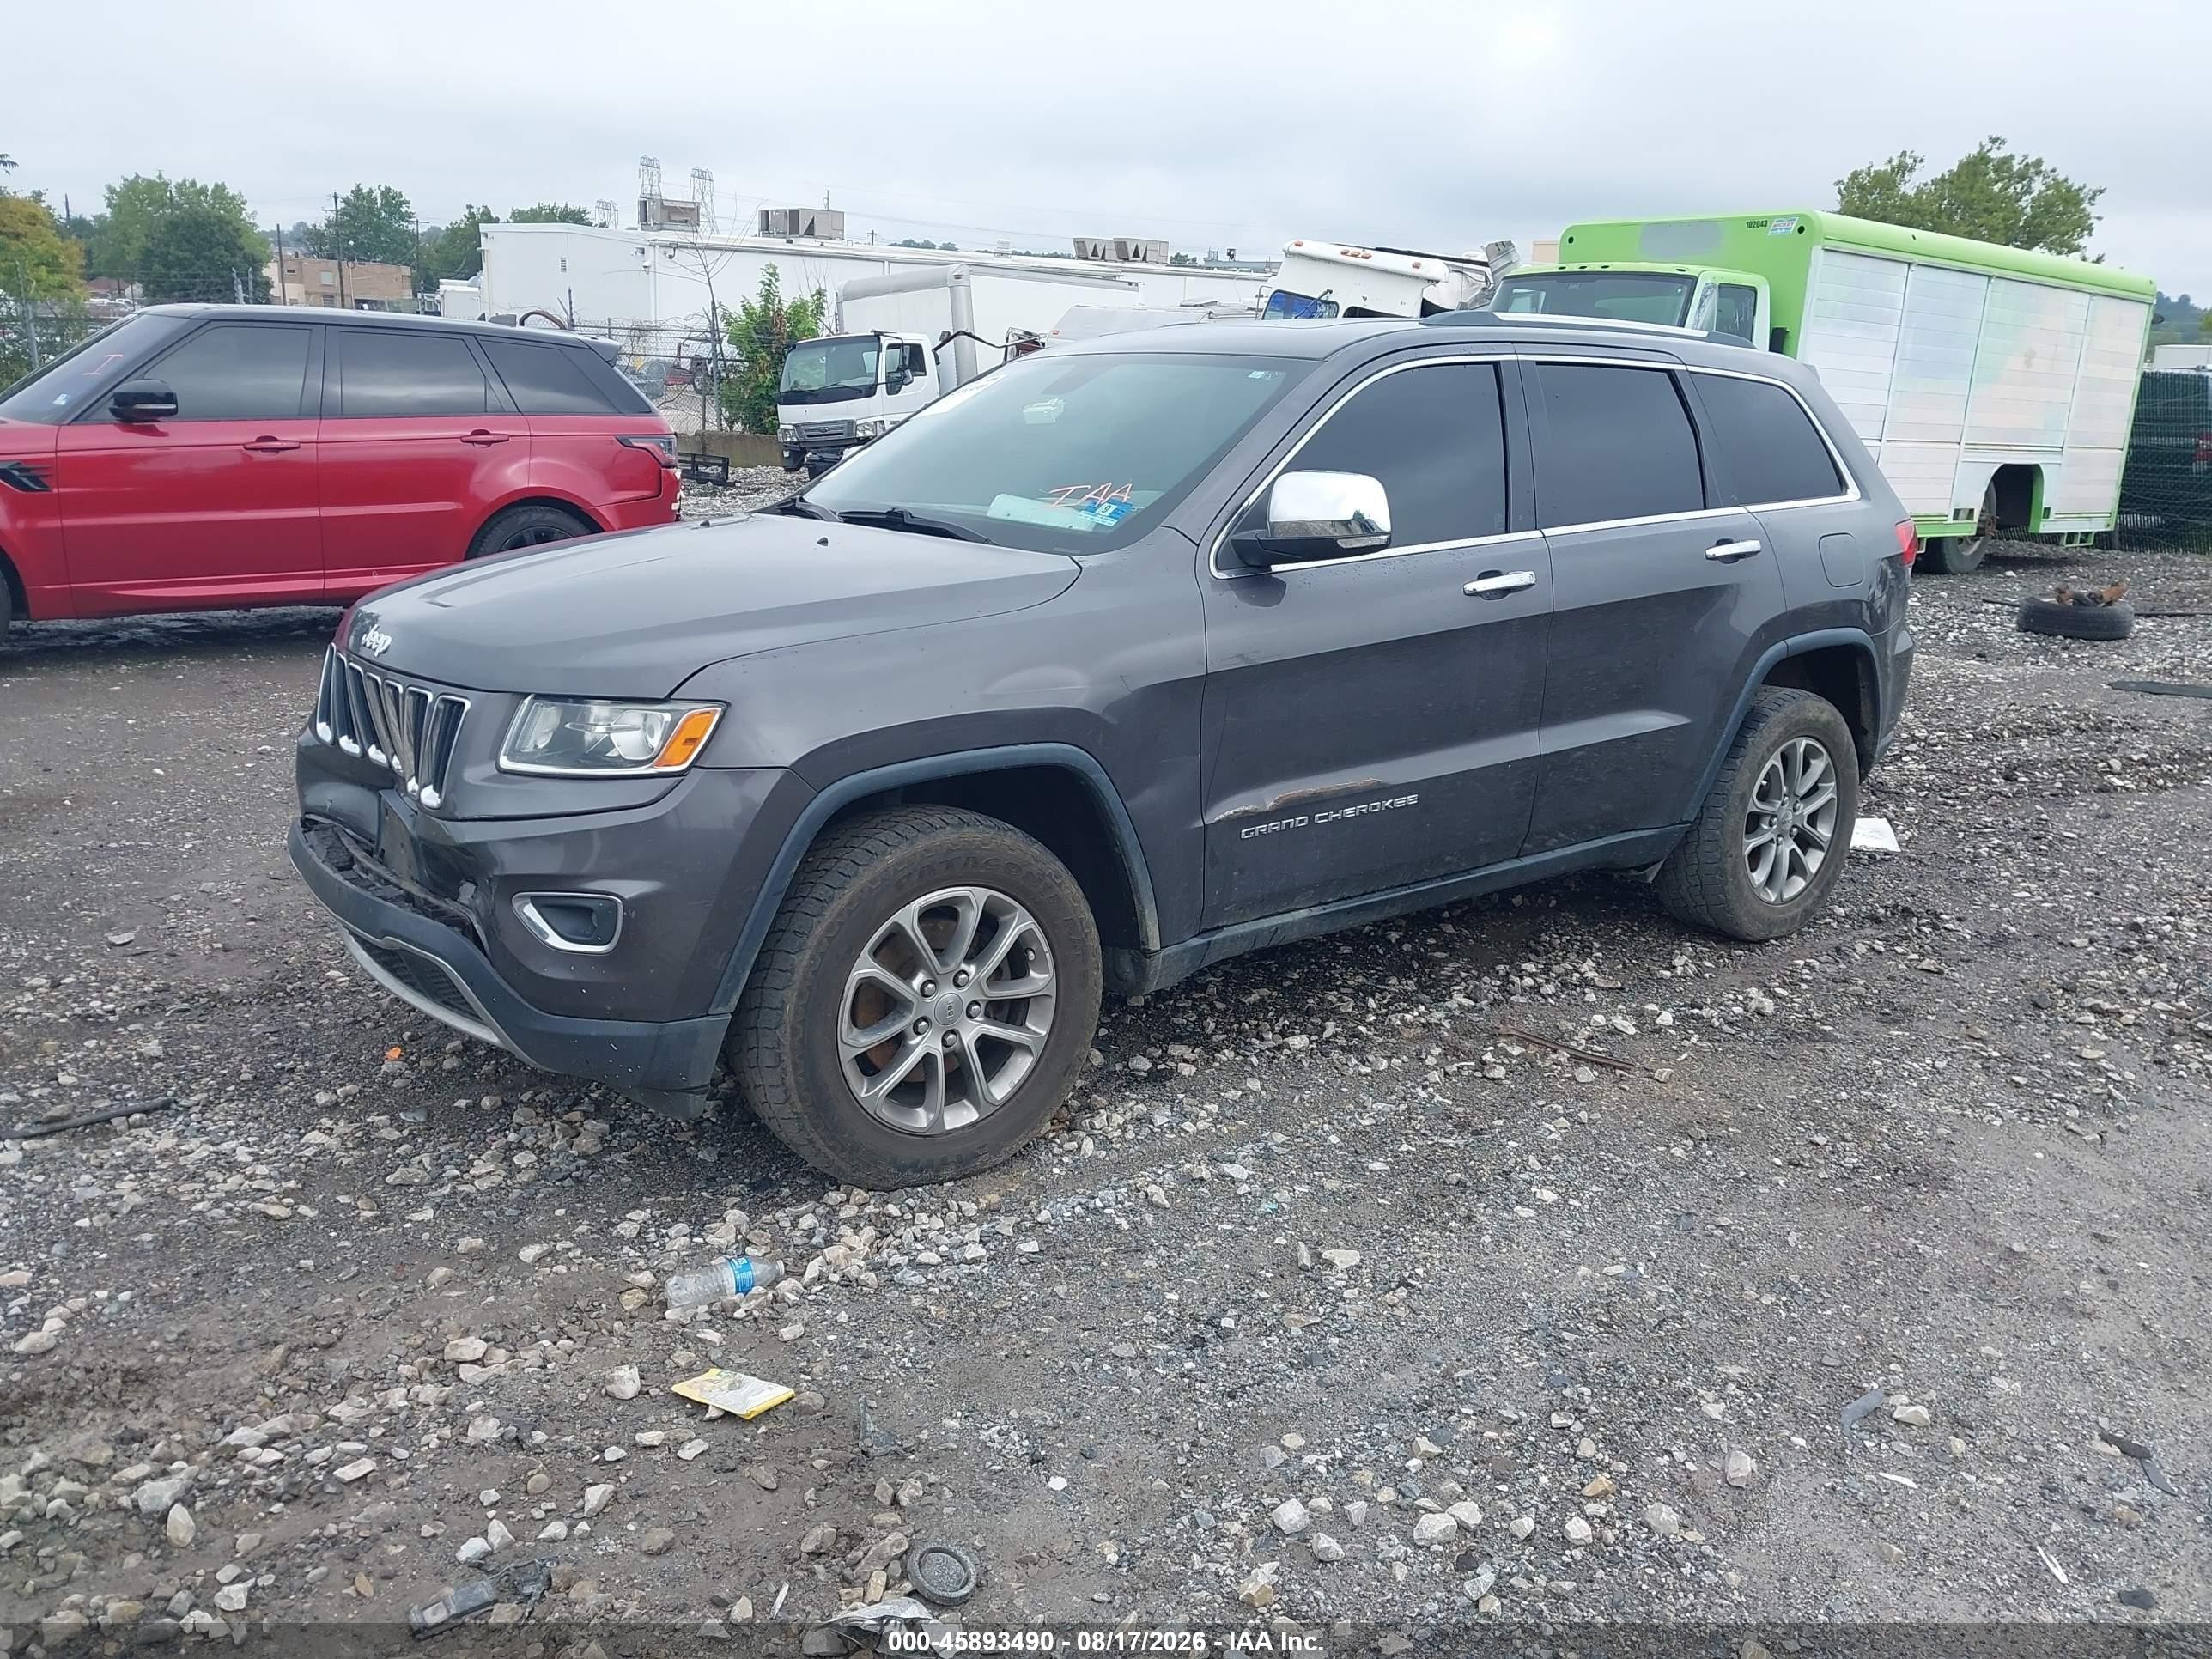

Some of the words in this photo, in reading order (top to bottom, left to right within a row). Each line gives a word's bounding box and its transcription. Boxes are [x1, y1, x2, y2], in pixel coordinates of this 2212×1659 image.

[1746, 219, 1768, 228] 102043
[361, 623, 392, 657] Jeep
[1240, 815, 1309, 840] GRAND
[1314, 793, 1419, 823] CHEROKEE
